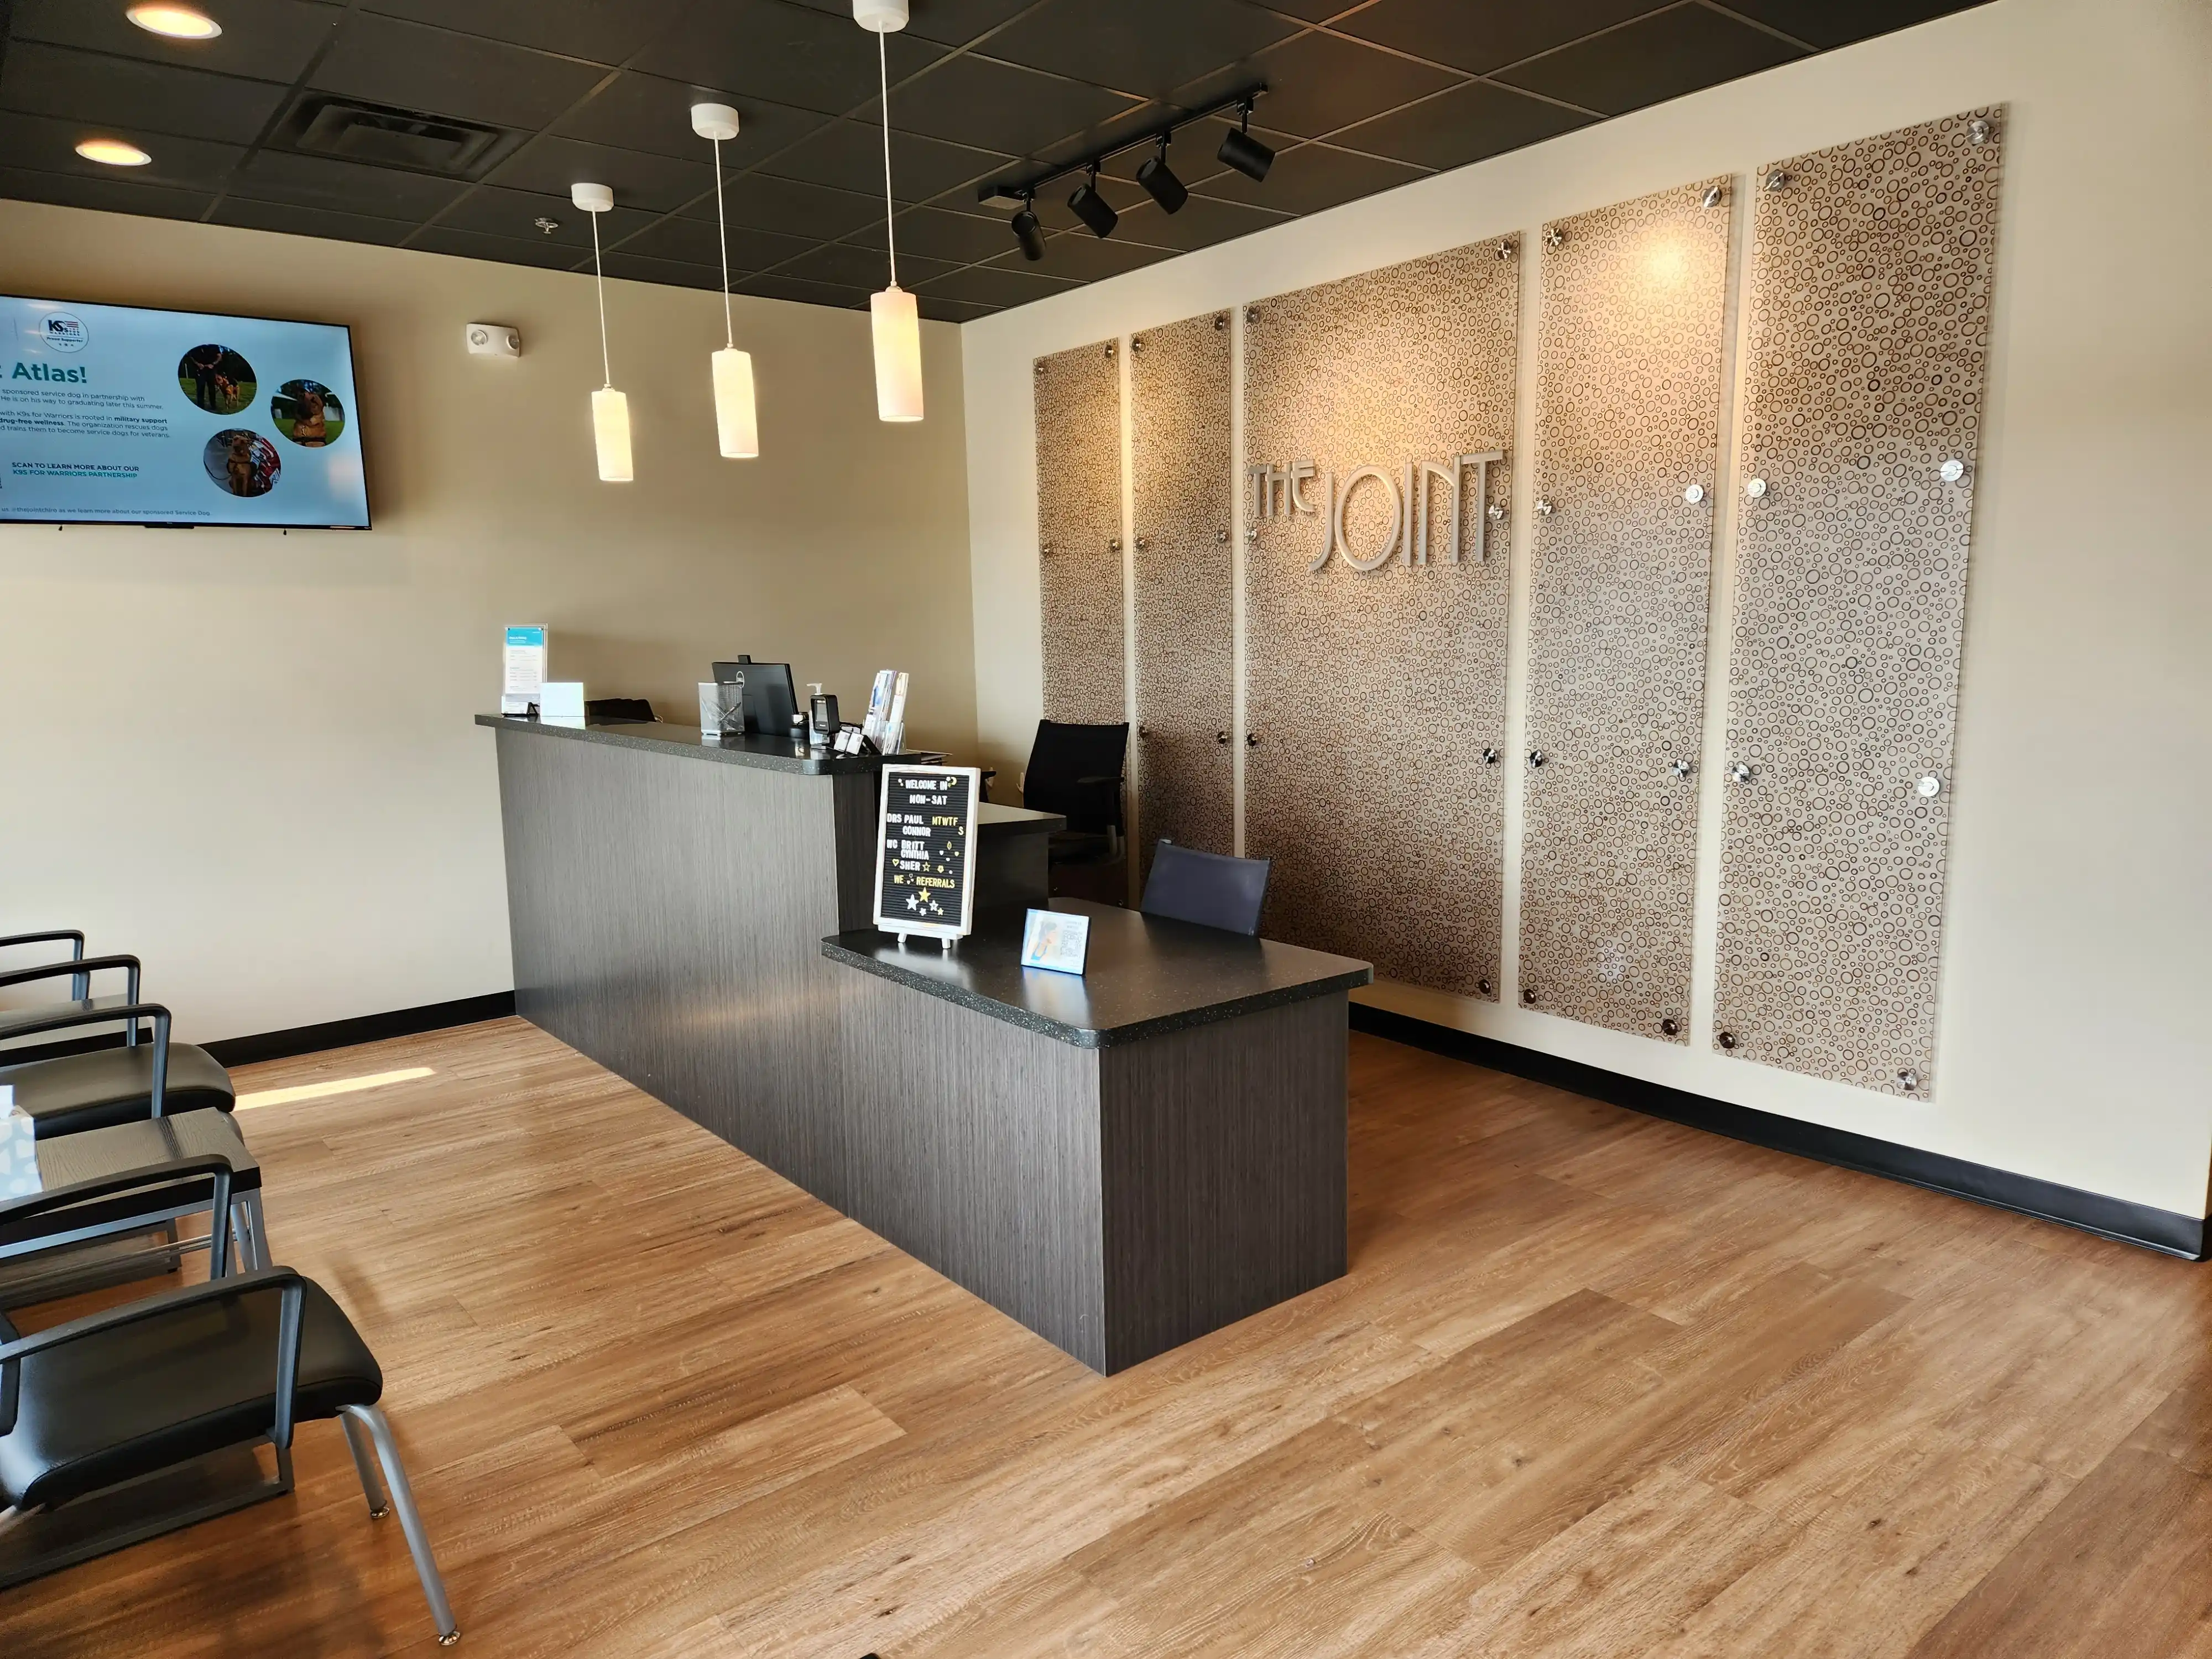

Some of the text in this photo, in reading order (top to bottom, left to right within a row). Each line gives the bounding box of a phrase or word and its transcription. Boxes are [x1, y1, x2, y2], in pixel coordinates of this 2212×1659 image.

[12, 362, 87, 383] Atlas!
[1248, 450, 1505, 572] THE JOINT
[905, 780, 947, 790] WELCOME IN
[909, 794, 948, 805] MON-SAT
[886, 813, 958, 826] DRS PAUL MTWTF
[902, 826, 964, 837] CONNOR S
[886, 839, 925, 851] WC BRITT
[900, 849, 929, 860] CYNTHIA
[899, 860, 921, 872] SHER
[894, 874, 956, 889] WE REFERRALS
